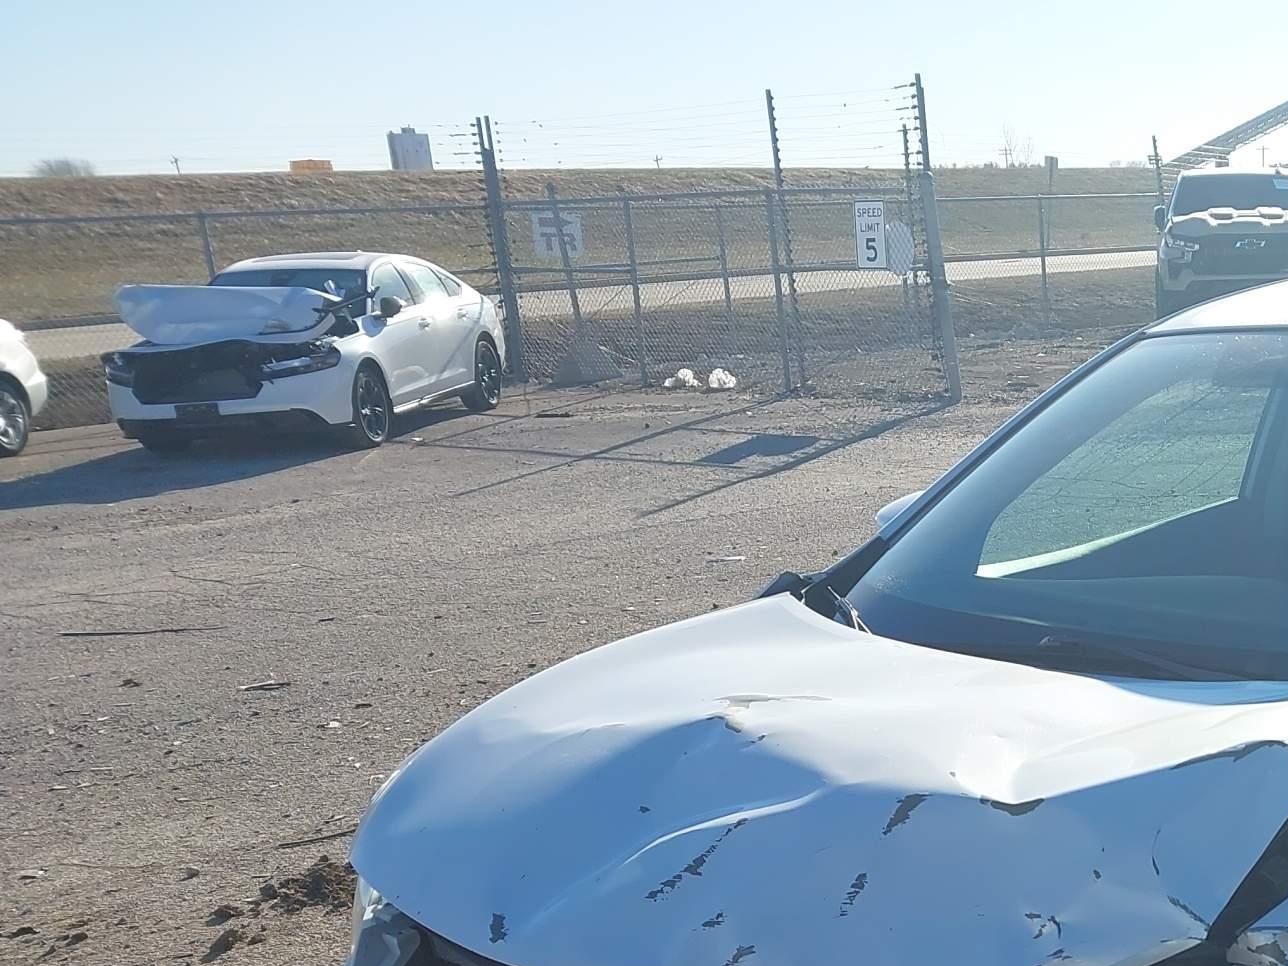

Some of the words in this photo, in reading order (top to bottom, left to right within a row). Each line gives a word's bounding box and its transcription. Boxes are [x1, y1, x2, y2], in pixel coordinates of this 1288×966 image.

[857, 207, 882, 218] SPEED
[859, 222, 880, 233] LIMIT
[865, 237, 878, 262] 5
